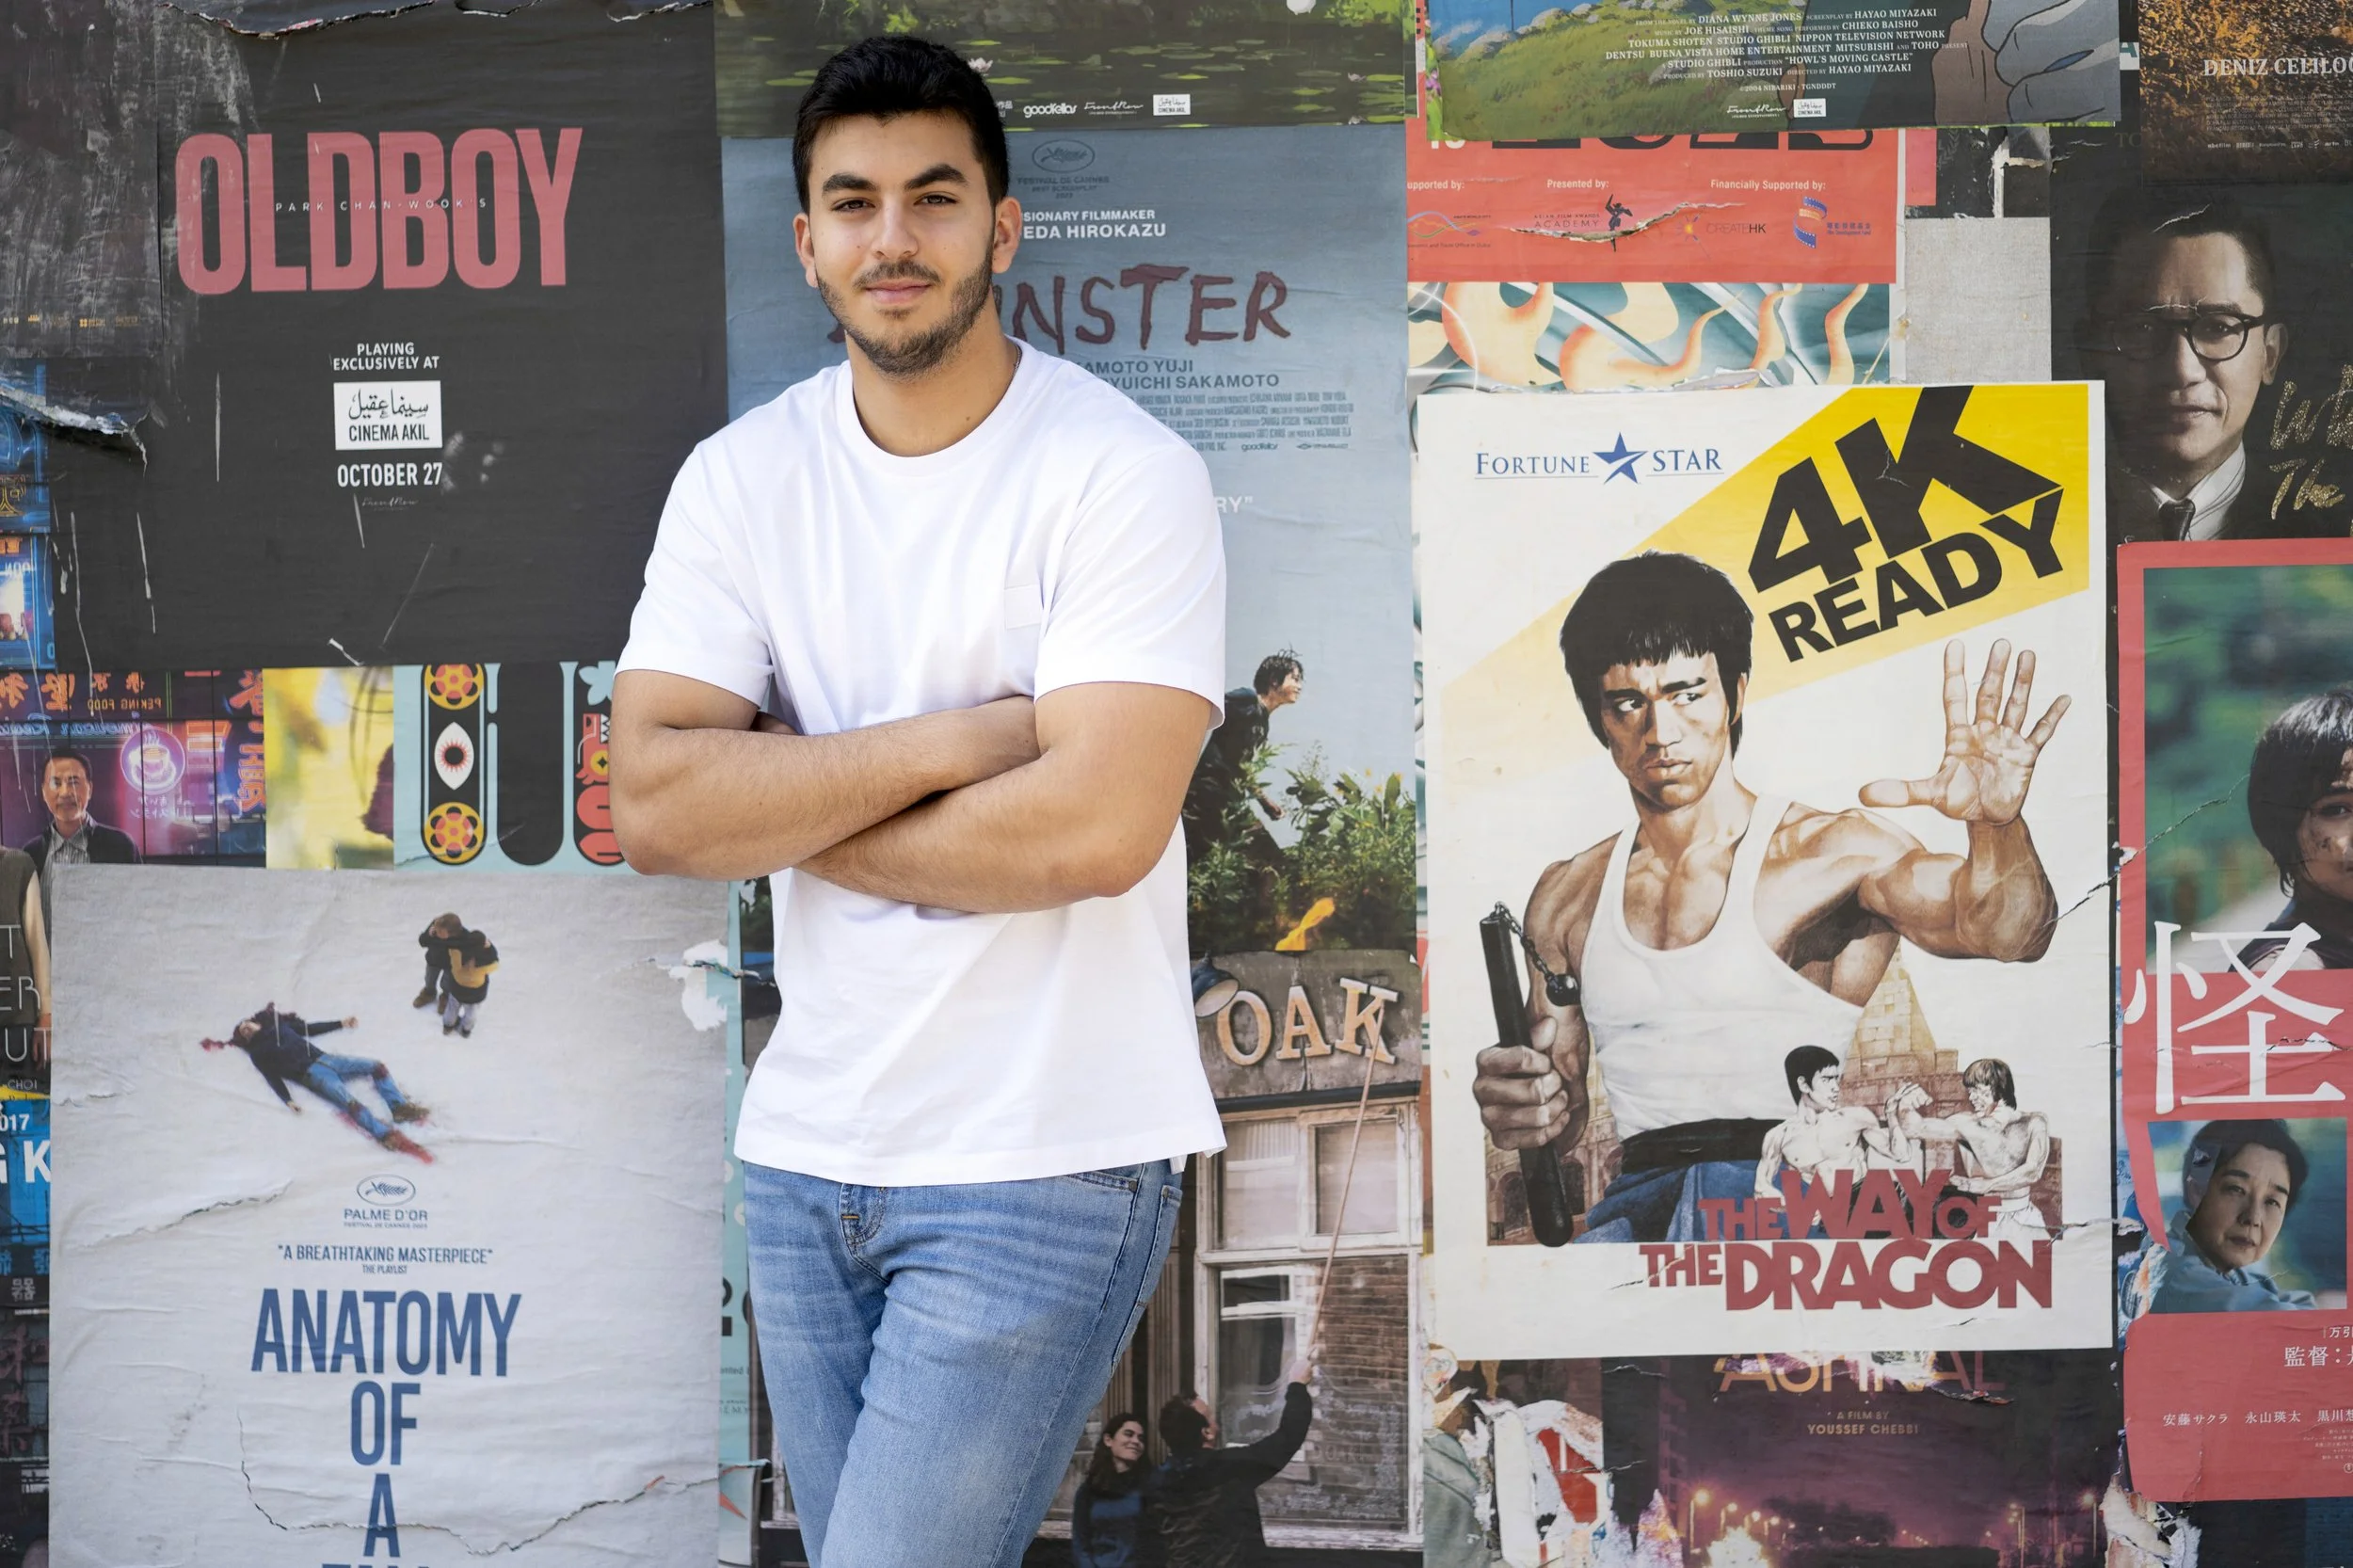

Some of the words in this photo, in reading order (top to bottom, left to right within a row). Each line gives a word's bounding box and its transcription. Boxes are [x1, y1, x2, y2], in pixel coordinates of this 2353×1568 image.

[1698, 14, 1730, 24] DIANA
[1732, 13, 1769, 23] WYNNE
[1770, 12, 1801, 22] JONES
[1854, 10, 1887, 19] HAYAO
[1889, 8, 1937, 18] MIYAZAKI
[1685, 26, 1703, 35] JOE
[1705, 25, 1749, 35] HISAISHI
[1842, 21, 1880, 30] CHIEKO
[1882, 20, 1919, 28] BAISHO
[1628, 39, 1670, 48] TOKUMA
[1673, 38, 1712, 46] SHOTEN
[1717, 36, 1753, 45] STUDIO
[1756, 35, 1790, 43] GHIBLI
[1795, 33, 1833, 42] NIPPON
[1835, 31, 1894, 41] TELEVISION
[1897, 30, 1945, 40] NETWORK
[1606, 51, 1644, 60] DENTSU
[1650, 50, 1682, 58] BUENA
[1716, 48, 1744, 56] HOME
[1748, 44, 1831, 55] ENTERTAINMENT
[1836, 42, 1894, 52] MITSUBISHI
[1912, 40, 1939, 49] TOHO
[1668, 59, 1705, 68] STUDIO
[1706, 58, 1741, 67] GHIBLI
[1830, 54, 1868, 63] MOVING
[1707, 69, 1744, 77] TOSHIO
[1747, 68, 1783, 76] SUZUKI
[1829, 65, 1861, 73] HAYAO
[1864, 63, 1912, 72] MIYAZAKI
[1023, 103, 1077, 118] goodfellas
[1017, 177, 1057, 185] FESTIVAL
[1074, 175, 1110, 184] CANNES
[1407, 180, 1449, 191] upported
[1450, 179, 1465, 191] by:
[1546, 179, 1593, 188] Presented
[1594, 179, 1609, 190] by:
[1710, 179, 1759, 191] Financially
[1762, 179, 1809, 191] Supported
[1812, 180, 1826, 191] by:
[175, 128, 583, 295] OLDBOY
[276, 200, 326, 213] PARK
[1022, 210, 1080, 222] SIONARY
[1081, 209, 1156, 221] FILMMAKER
[1022, 225, 1062, 239] EDA
[1066, 223, 1167, 239] HIROKAZU
[1535, 219, 1599, 229] ACADEMY
[1706, 223, 1766, 233] CREATEHK
[993, 264, 1290, 354] NSTER
[357, 342, 415, 356] PLAYING
[333, 357, 419, 371] EXCLUSIVELY
[423, 355, 440, 370] AT
[1079, 360, 1149, 374] AMOTO
[1154, 359, 1193, 373] YUJI
[1105, 376, 1171, 390] YUICHI
[1176, 374, 1279, 390] SAKAMOTO
[348, 424, 398, 442] CINEMA
[402, 424, 430, 441] AKIL
[1475, 451, 1591, 475] FORTUNE
[1652, 447, 1722, 472] STAR
[337, 462, 419, 488] OCTOBER
[424, 461, 443, 486] 27
[1748, 385, 2063, 594] 4K
[2269, 458, 2345, 520] The
[1768, 488, 2065, 664] READY
[1217, 977, 1399, 1066] OAK
[2124, 920, 2347, 1114] 怪
[1698, 1196, 1786, 1241] THE
[1781, 1169, 1951, 1240] WAY
[1935, 1194, 2003, 1239] OF
[343, 1208, 391, 1222] PALME
[393, 1208, 428, 1222] D'OR
[296, 1244, 394, 1263] BREATHTAKING
[361, 1264, 375, 1273] THE
[376, 1264, 408, 1274] PLAYLIST
[1640, 1243, 1724, 1288] THE
[1724, 1237, 2053, 1311] DRAGON
[251, 1288, 521, 1377] ANATOMY
[1836, 1411, 1845, 1419] A
[1847, 1411, 1872, 1419] FILM
[1876, 1410, 1889, 1419] BY
[2163, 1413, 2229, 1427] 安藤サクラ
[2245, 1410, 2301, 1424] 永山瑛太
[350, 1381, 421, 1465] OF
[1807, 1424, 1865, 1434] YOUSSEF
[1870, 1423, 1919, 1434] CHEBBI
[362, 1473, 401, 1558] A
